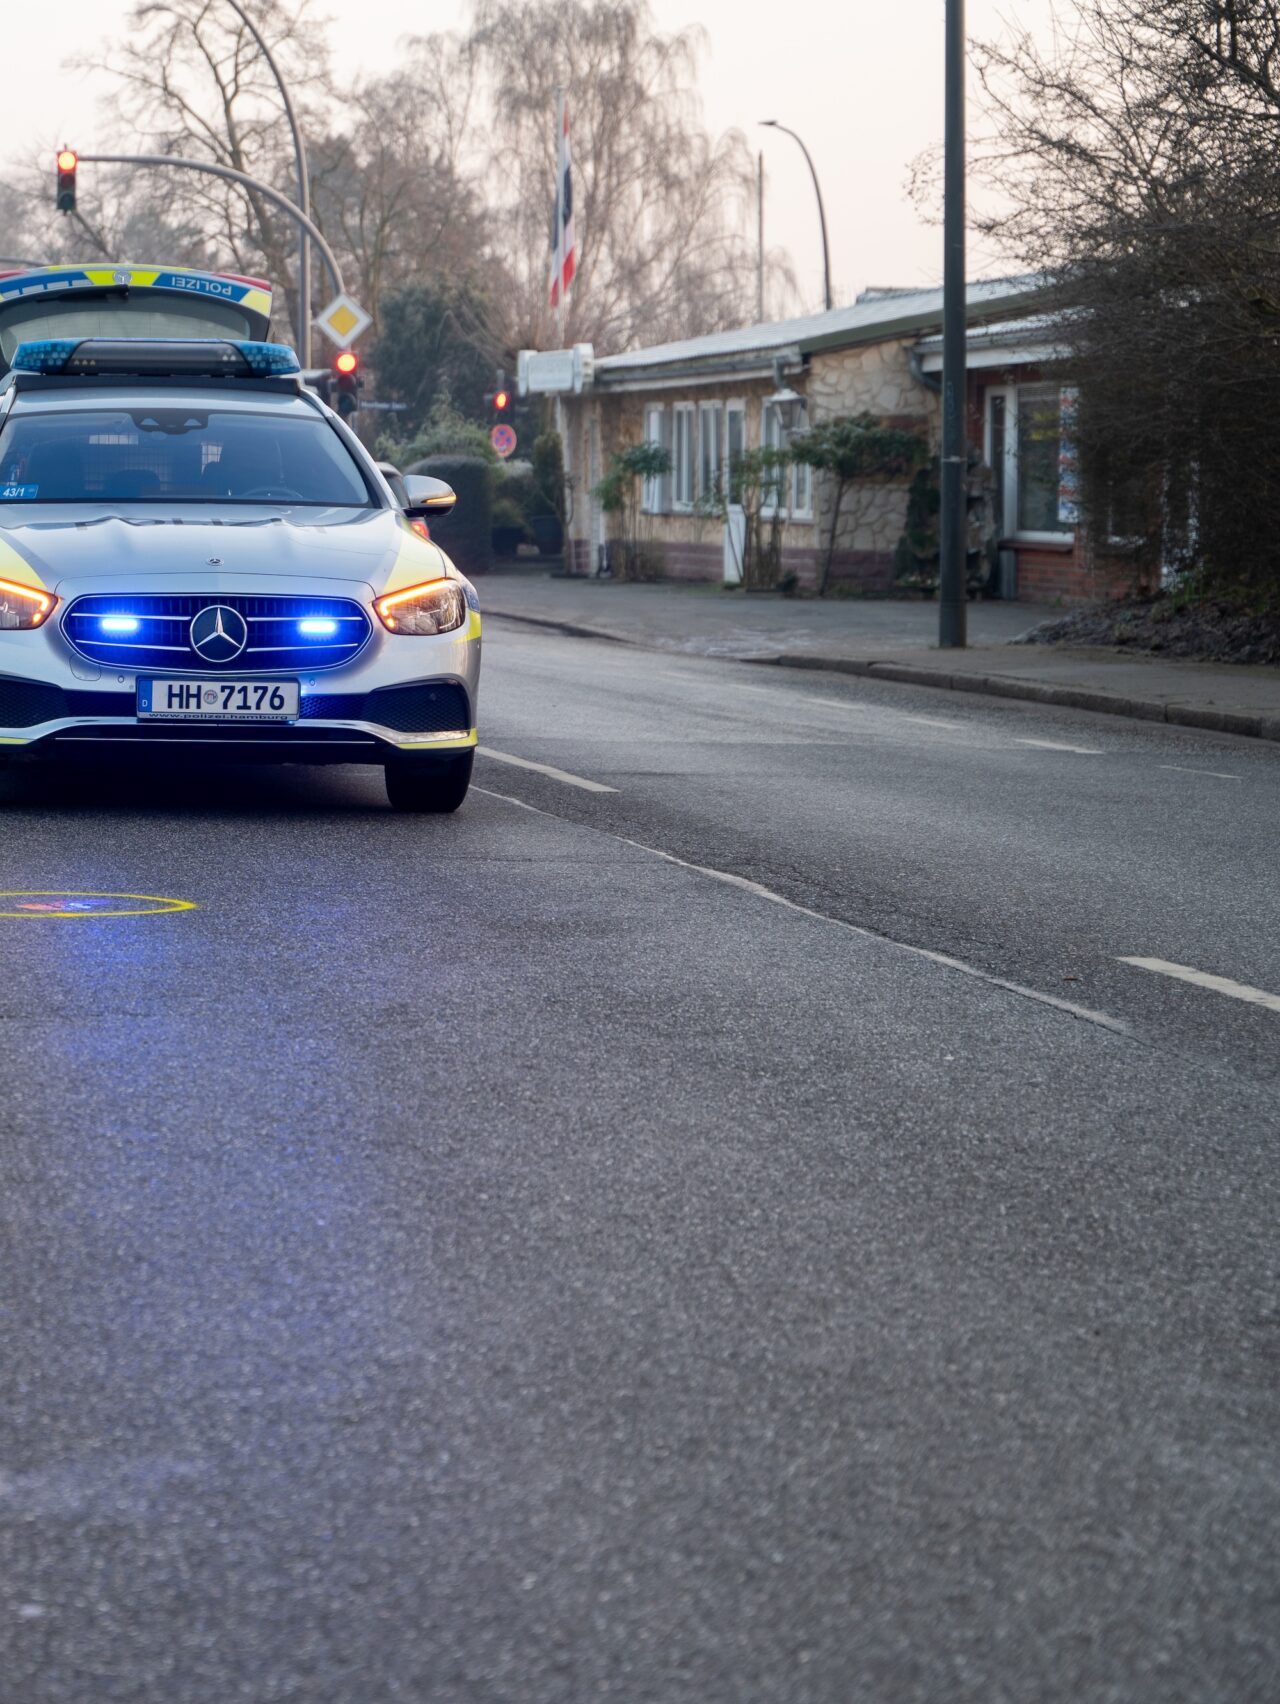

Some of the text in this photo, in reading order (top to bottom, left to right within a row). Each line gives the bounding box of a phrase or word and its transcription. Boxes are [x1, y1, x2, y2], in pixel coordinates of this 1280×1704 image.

[171, 276, 232, 296] POLIZEI
[3, 487, 25, 497] 43/1
[167, 684, 285, 711] HH 7176
